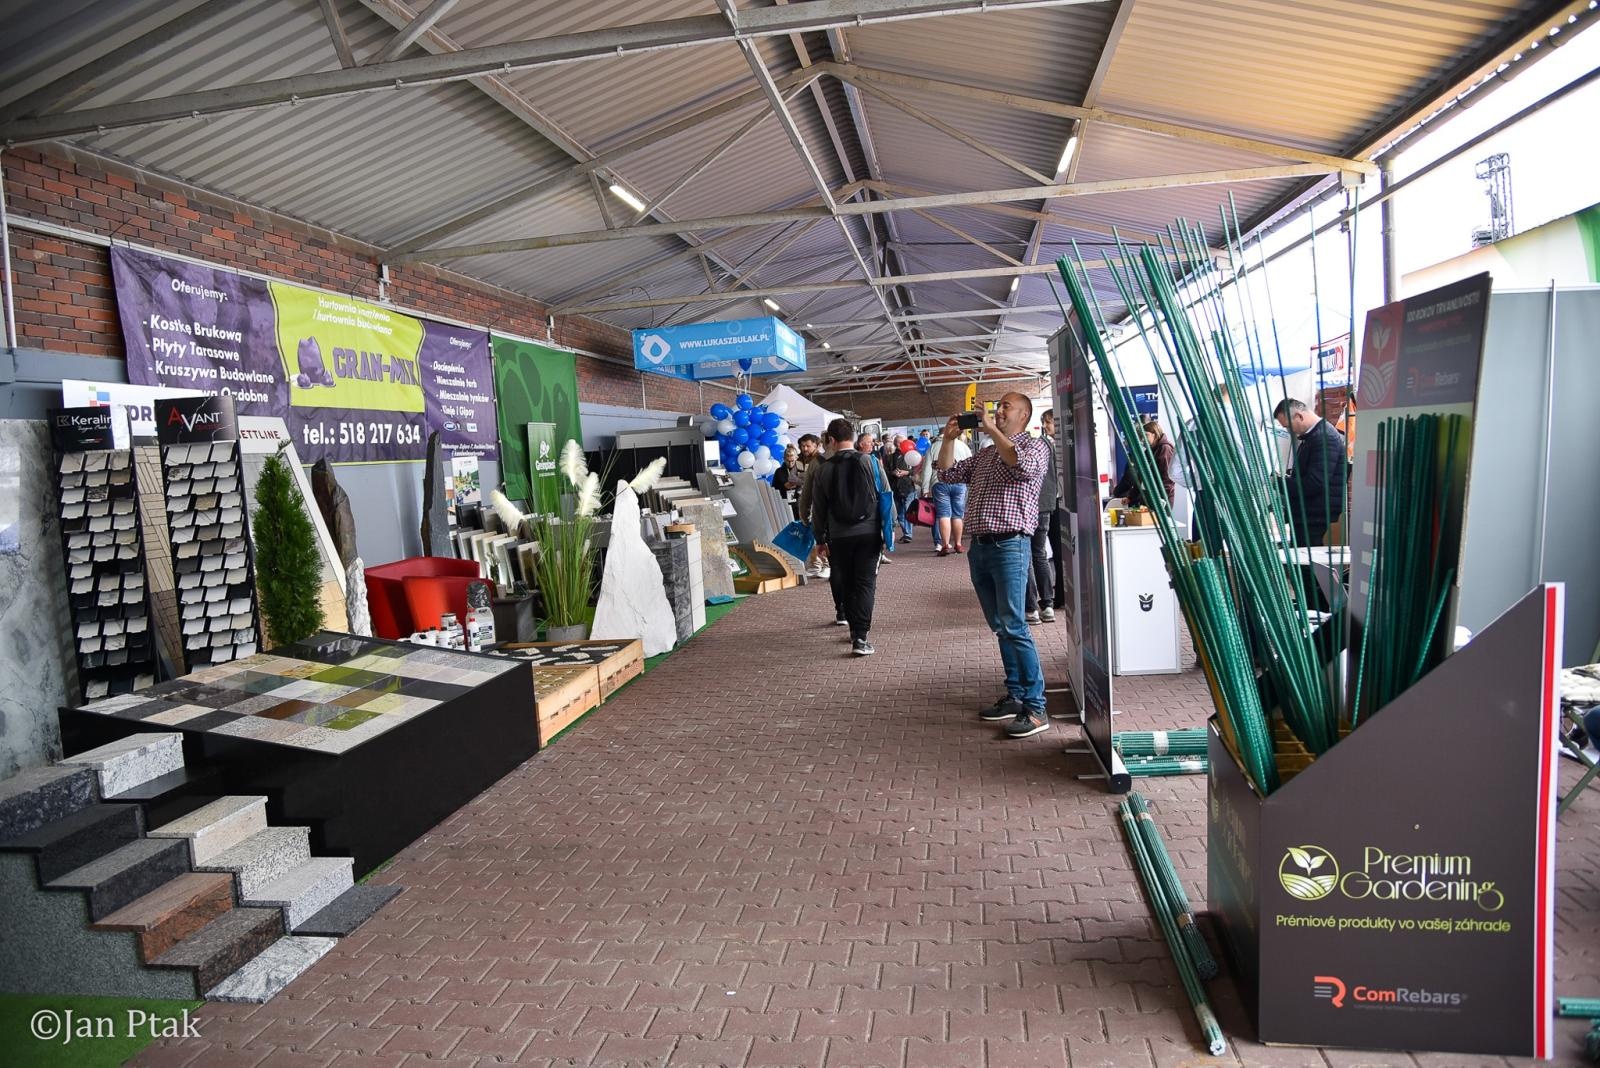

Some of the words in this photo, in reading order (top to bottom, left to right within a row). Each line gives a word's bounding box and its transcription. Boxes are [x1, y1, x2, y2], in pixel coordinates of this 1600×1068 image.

[171, 278, 229, 302] Oferujemy:
[150, 314, 192, 335] Kostkę
[193, 323, 243, 343] Brukową
[152, 337, 187, 358] Płyty
[189, 341, 240, 361] Tarasowe
[155, 360, 218, 382] Kruszywa
[220, 368, 274, 384] Budowlane
[167, 407, 220, 432] AVANT
[239, 430, 281, 440] ETTLINE
[303, 422, 336, 445] tel.:
[339, 422, 366, 444] 518
[369, 422, 393, 444] 217
[396, 424, 421, 445] 634
[1364, 846, 1472, 876] Premium
[1340, 870, 1505, 912] Gardening
[1276, 913, 1337, 929] Prémiové
[1338, 916, 1397, 933] produkty
[1399, 919, 1416, 931] vo
[1417, 916, 1453, 934] vašej
[1454, 917, 1512, 933] záhrade
